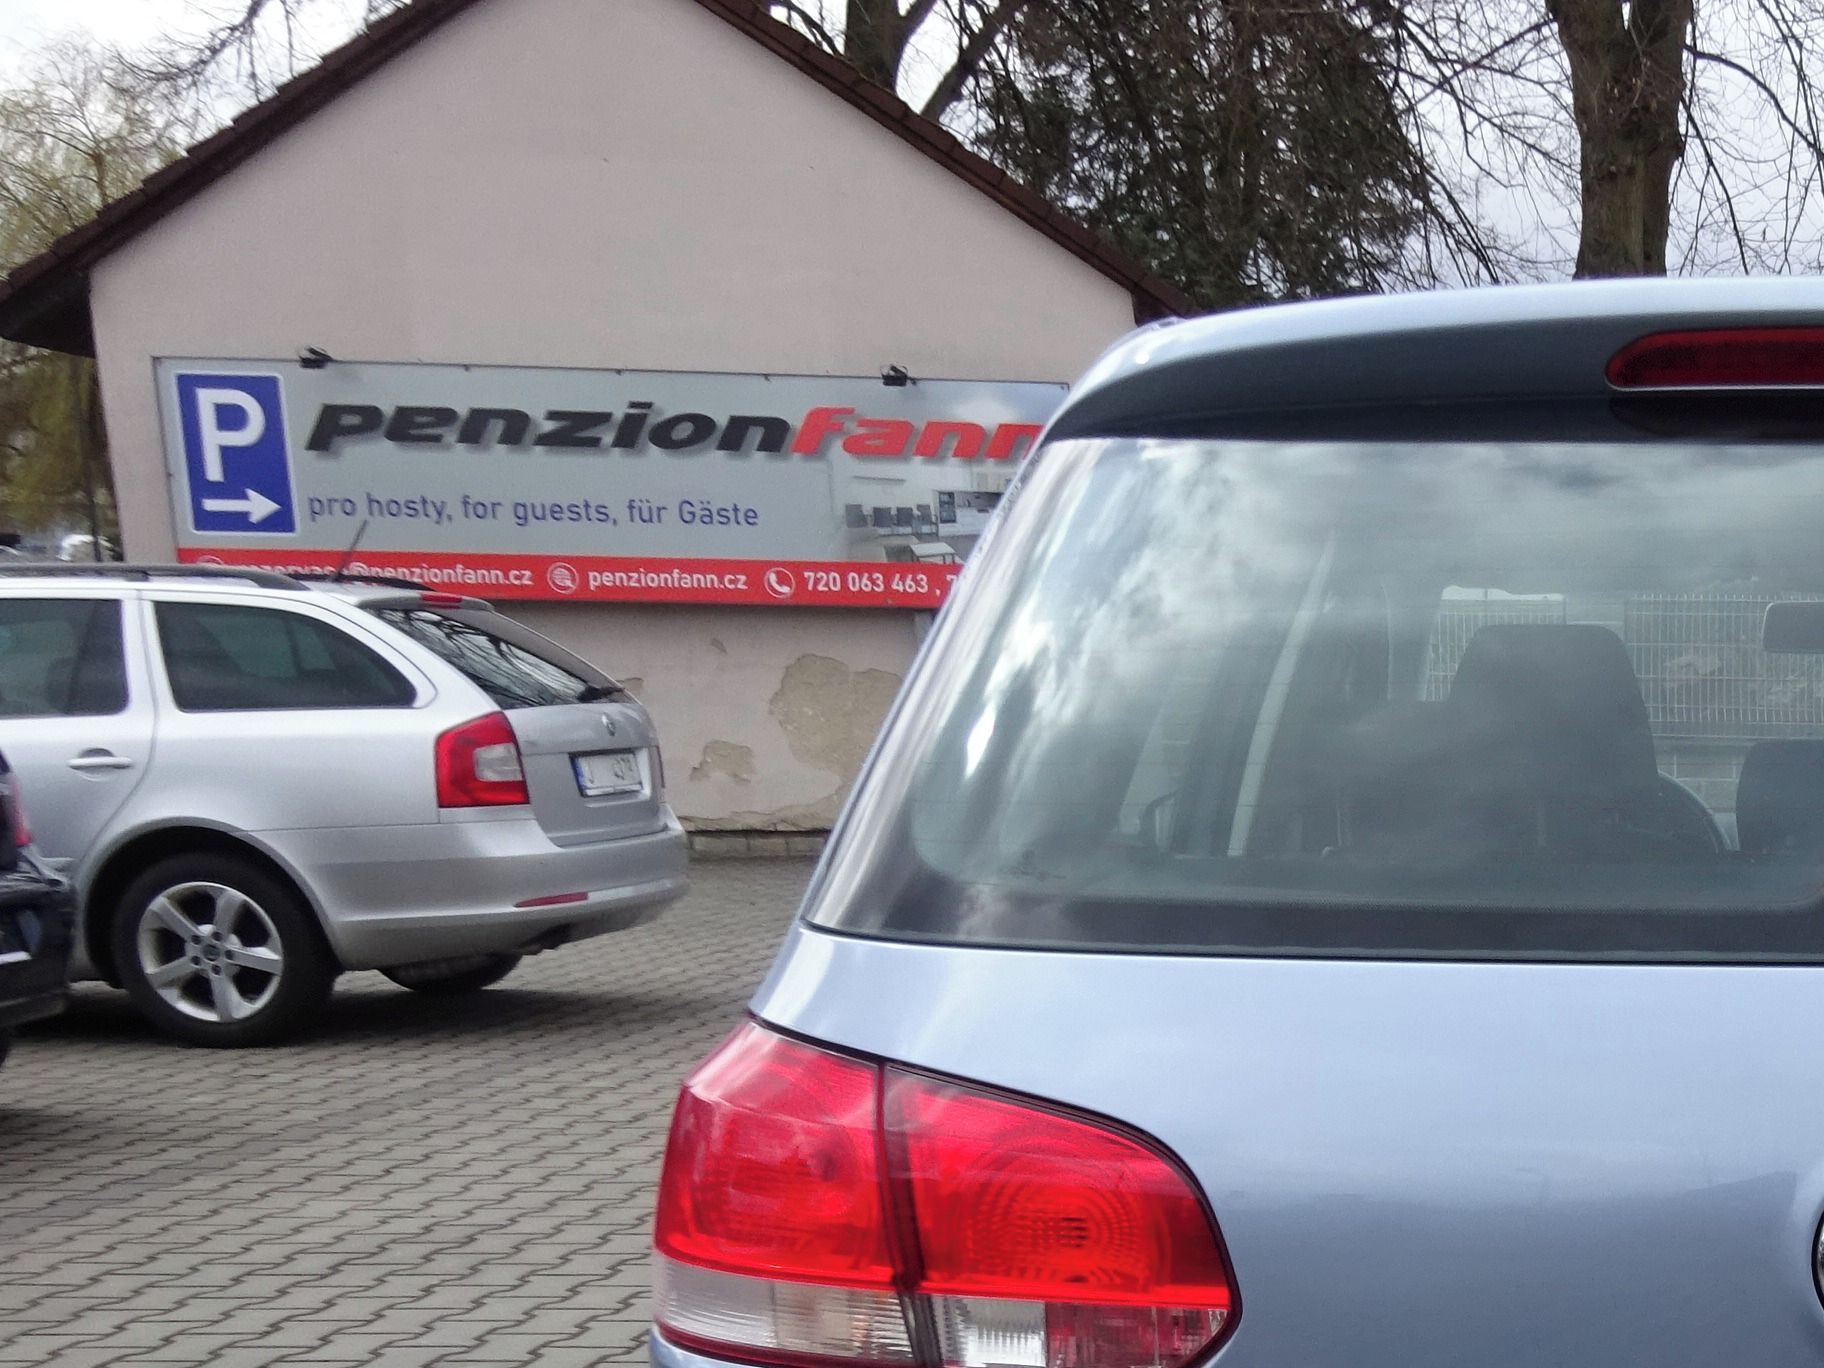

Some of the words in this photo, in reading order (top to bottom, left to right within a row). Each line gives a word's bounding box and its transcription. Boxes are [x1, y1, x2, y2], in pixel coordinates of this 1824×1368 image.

[195, 387, 266, 483] P
[309, 495, 356, 522] pro
[366, 492, 453, 525] hosty,
[463, 495, 500, 520] for
[512, 499, 618, 527] guests,
[627, 499, 669, 524] für
[677, 499, 760, 527] Gäste
[586, 567, 749, 591] penzionfann.cz
[802, 570, 842, 592] 720
[848, 572, 885, 593] 063
